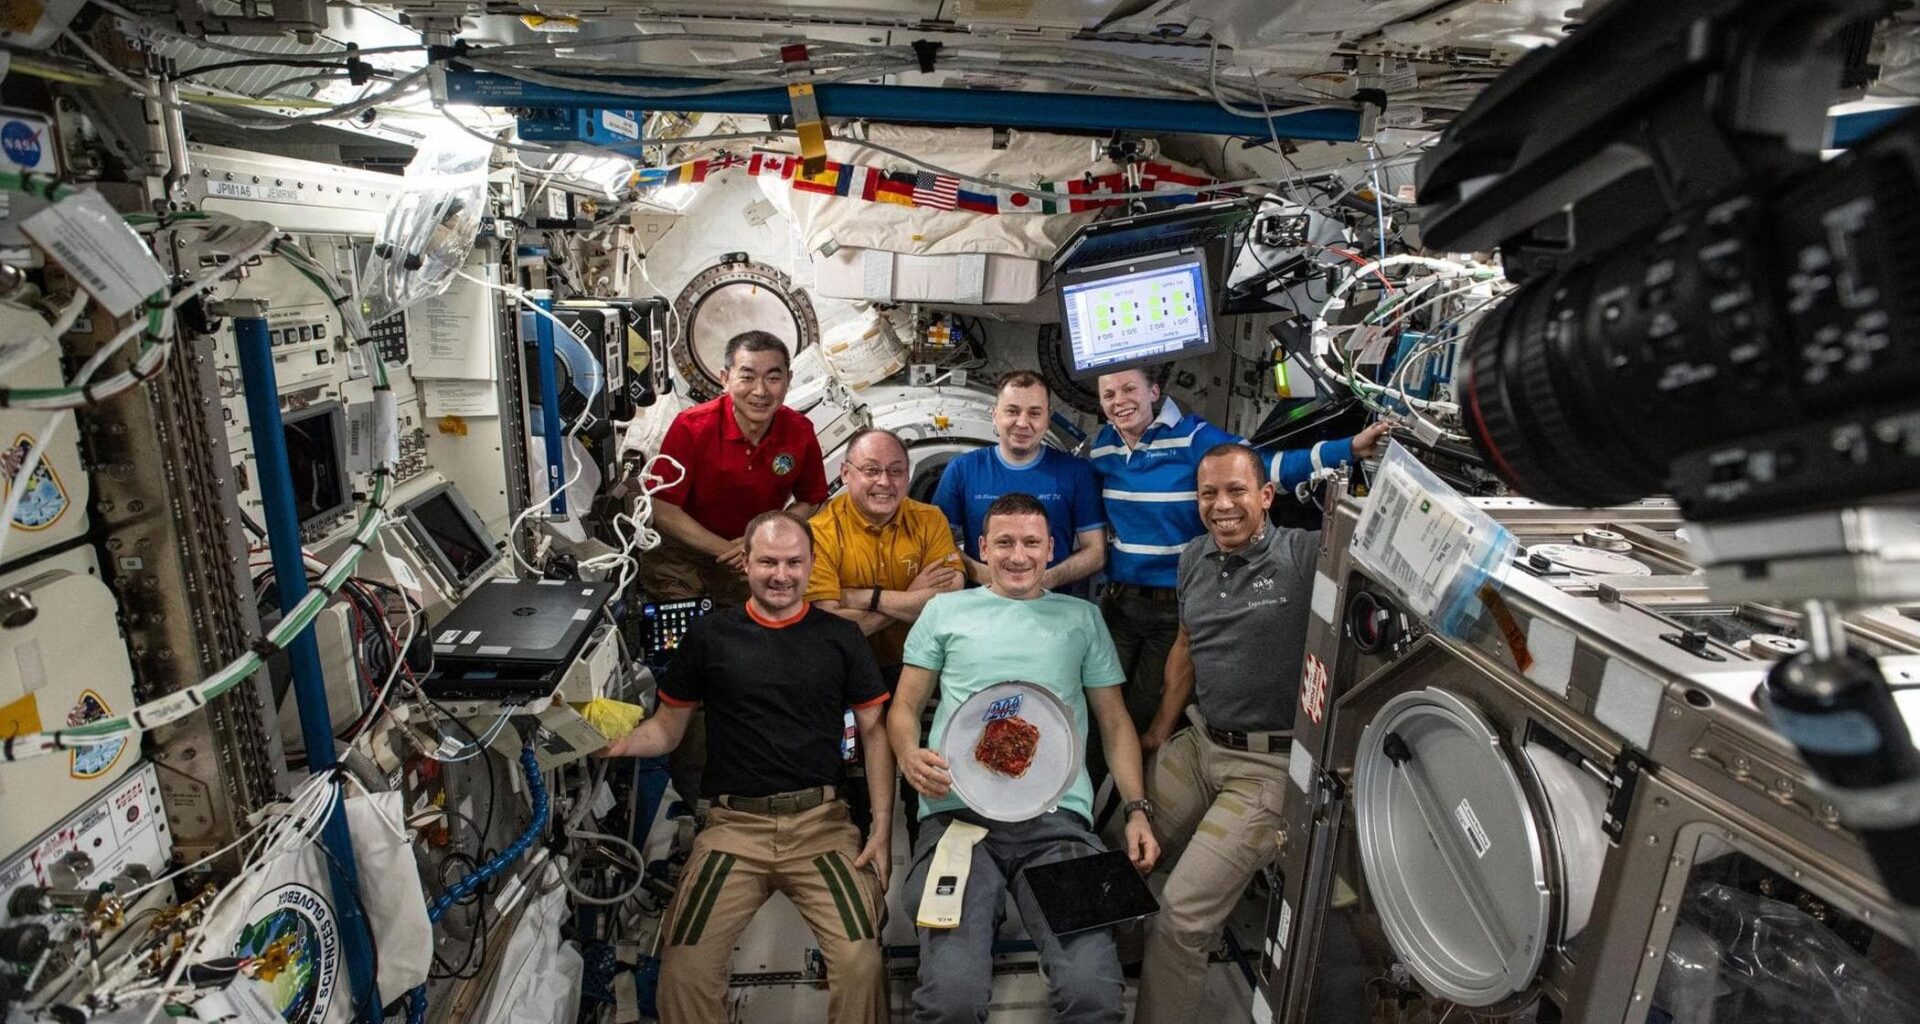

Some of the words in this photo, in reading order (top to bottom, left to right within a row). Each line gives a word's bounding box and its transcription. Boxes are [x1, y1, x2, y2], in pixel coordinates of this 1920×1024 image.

[4, 137, 39, 152] NASA
[216, 183, 252, 197] JPM1A6
[1252, 578, 1275, 590] NASA
[277, 890, 326, 921] GLOVEBOX
[319, 920, 335, 999] SCIENCES
